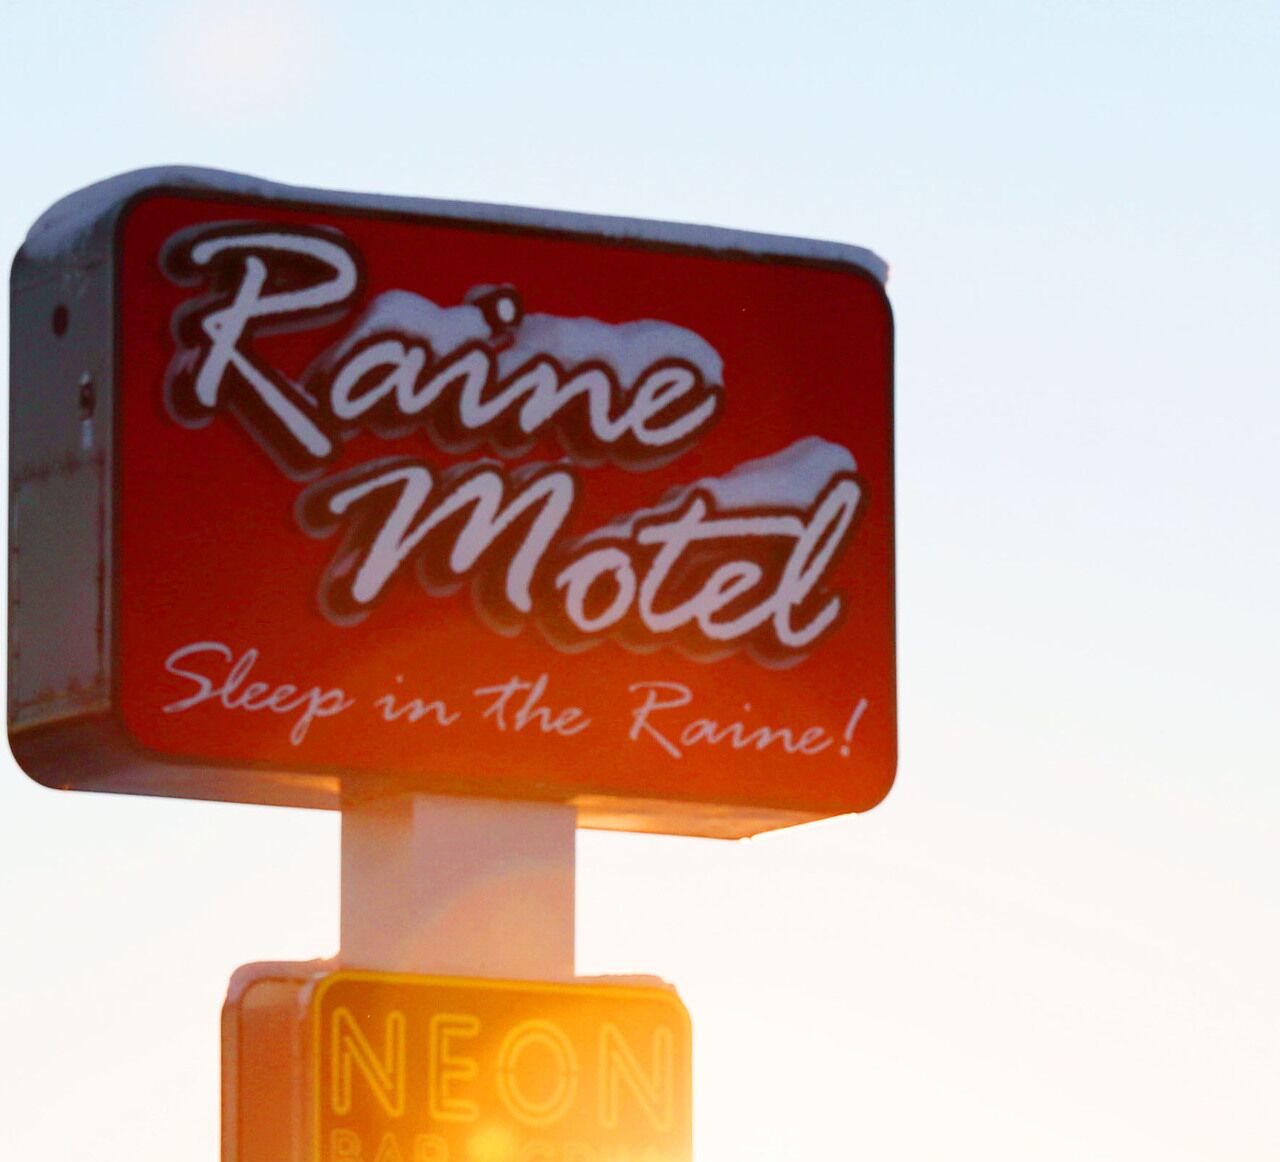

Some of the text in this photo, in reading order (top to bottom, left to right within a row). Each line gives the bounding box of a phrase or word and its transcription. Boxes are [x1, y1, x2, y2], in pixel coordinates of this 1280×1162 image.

[192, 230, 719, 458] Raine
[329, 466, 861, 648] Motel
[162, 641, 869, 759] Sleep in the Raine!
[331, 1007, 674, 1131] NEON
